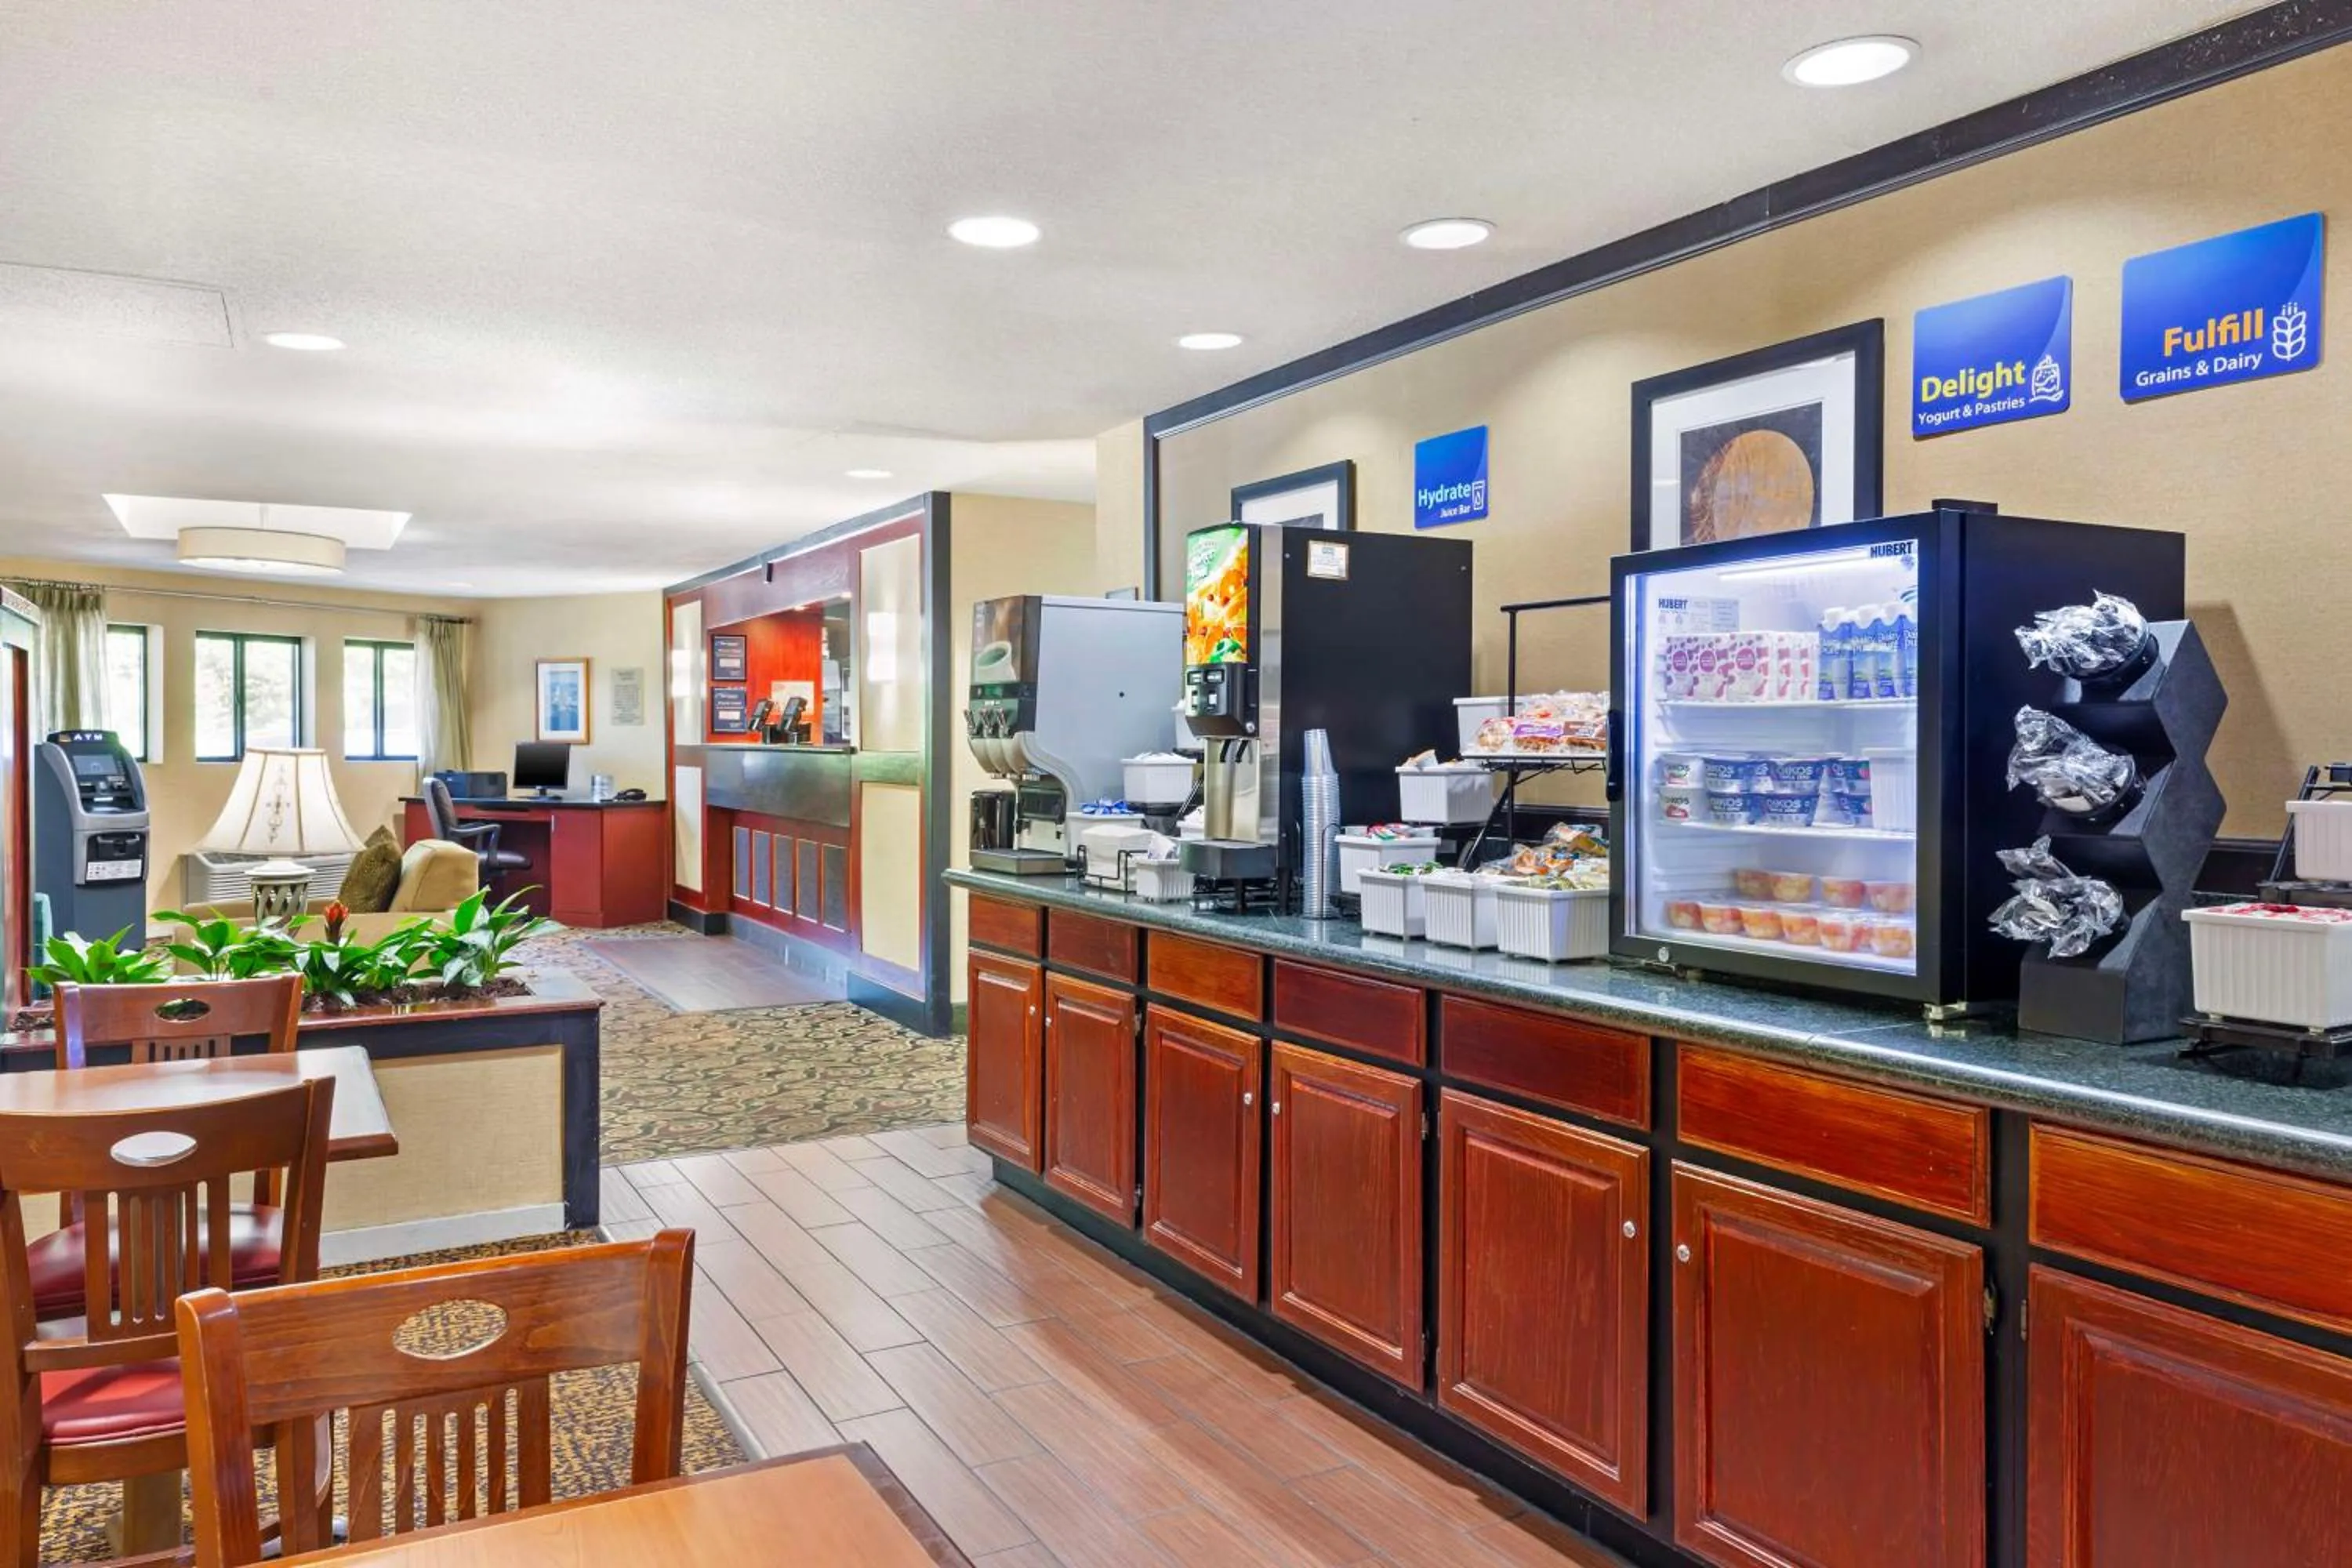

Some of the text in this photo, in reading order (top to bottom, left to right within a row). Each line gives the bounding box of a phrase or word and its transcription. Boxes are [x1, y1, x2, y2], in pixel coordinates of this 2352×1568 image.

[2164, 307, 2263, 358] Fulfill
[1922, 361, 2025, 402] Delight
[2136, 353, 2263, 387] Grains & Dairy
[1918, 397, 2025, 426] Yogurt & Pastries
[1418, 482, 1471, 510] Hydrate
[1458, 504, 1471, 514] Bar
[1870, 541, 1914, 558] HUBERT
[1658, 598, 1687, 609] HUBERT
